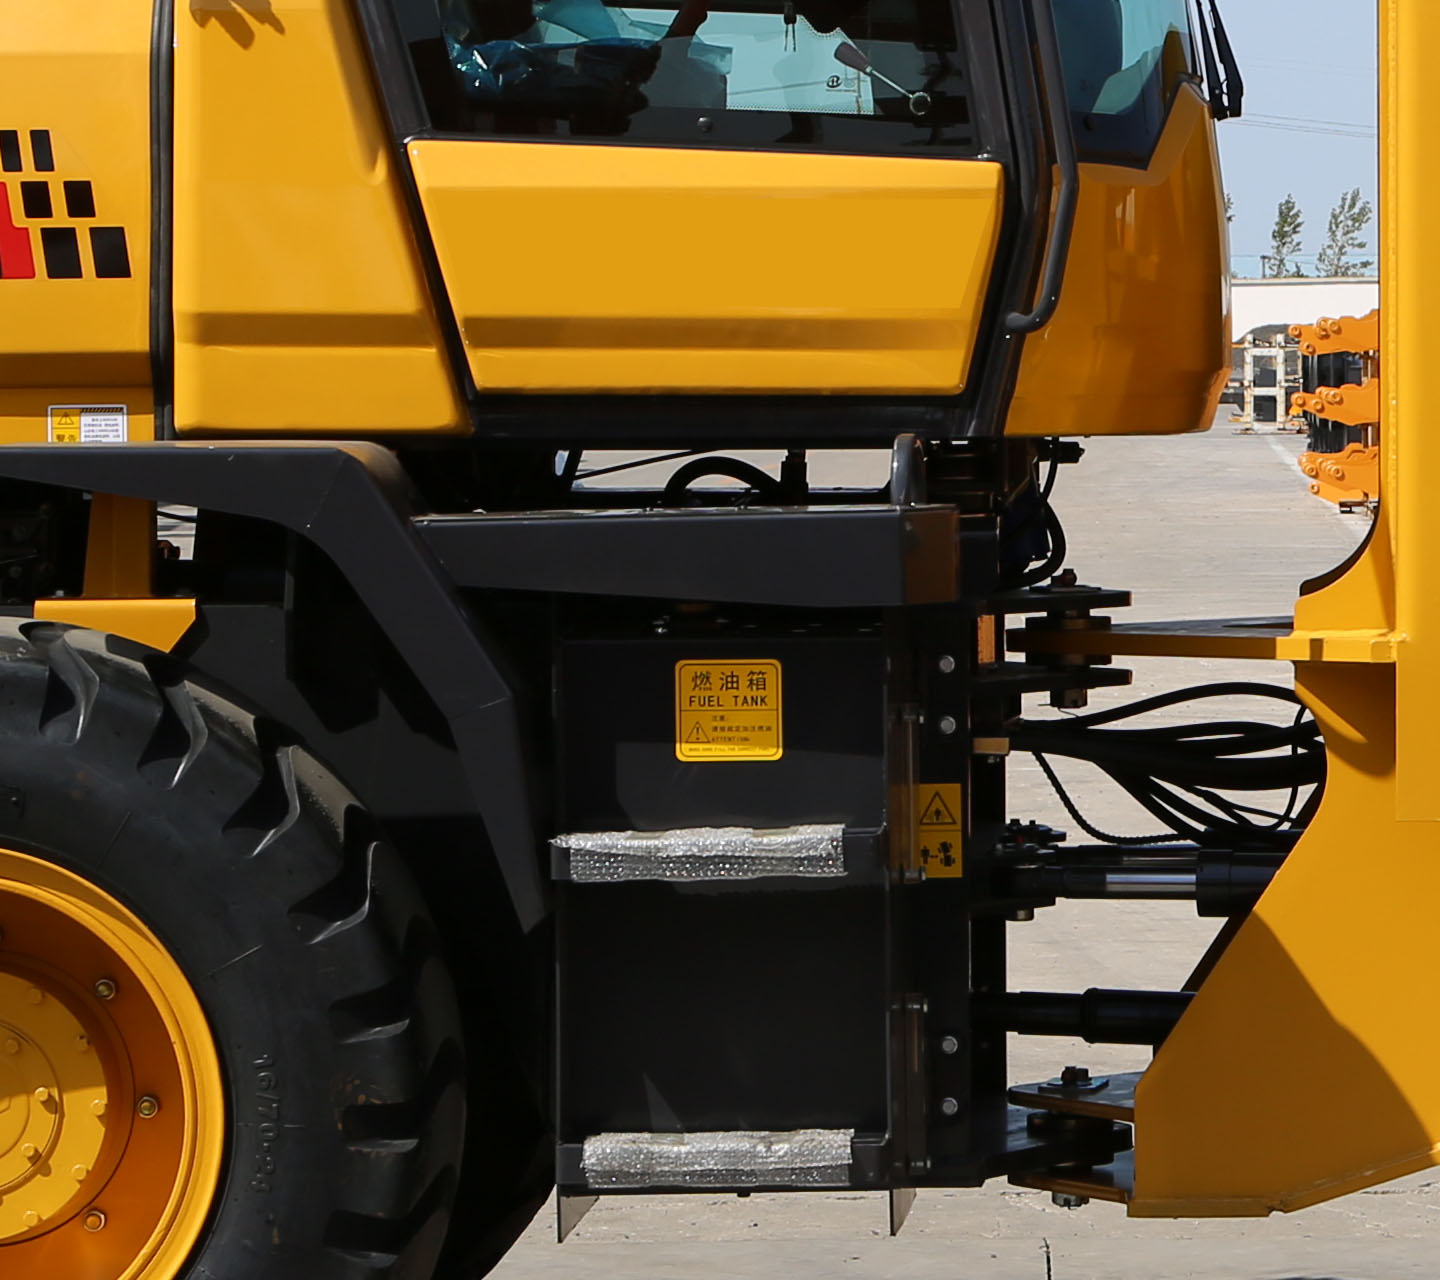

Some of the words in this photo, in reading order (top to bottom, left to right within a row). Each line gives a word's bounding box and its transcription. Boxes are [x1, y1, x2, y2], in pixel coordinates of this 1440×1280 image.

[691, 670, 767, 692] 燃油箱
[688, 695, 725, 708] FUEL
[732, 695, 769, 708] TANK
